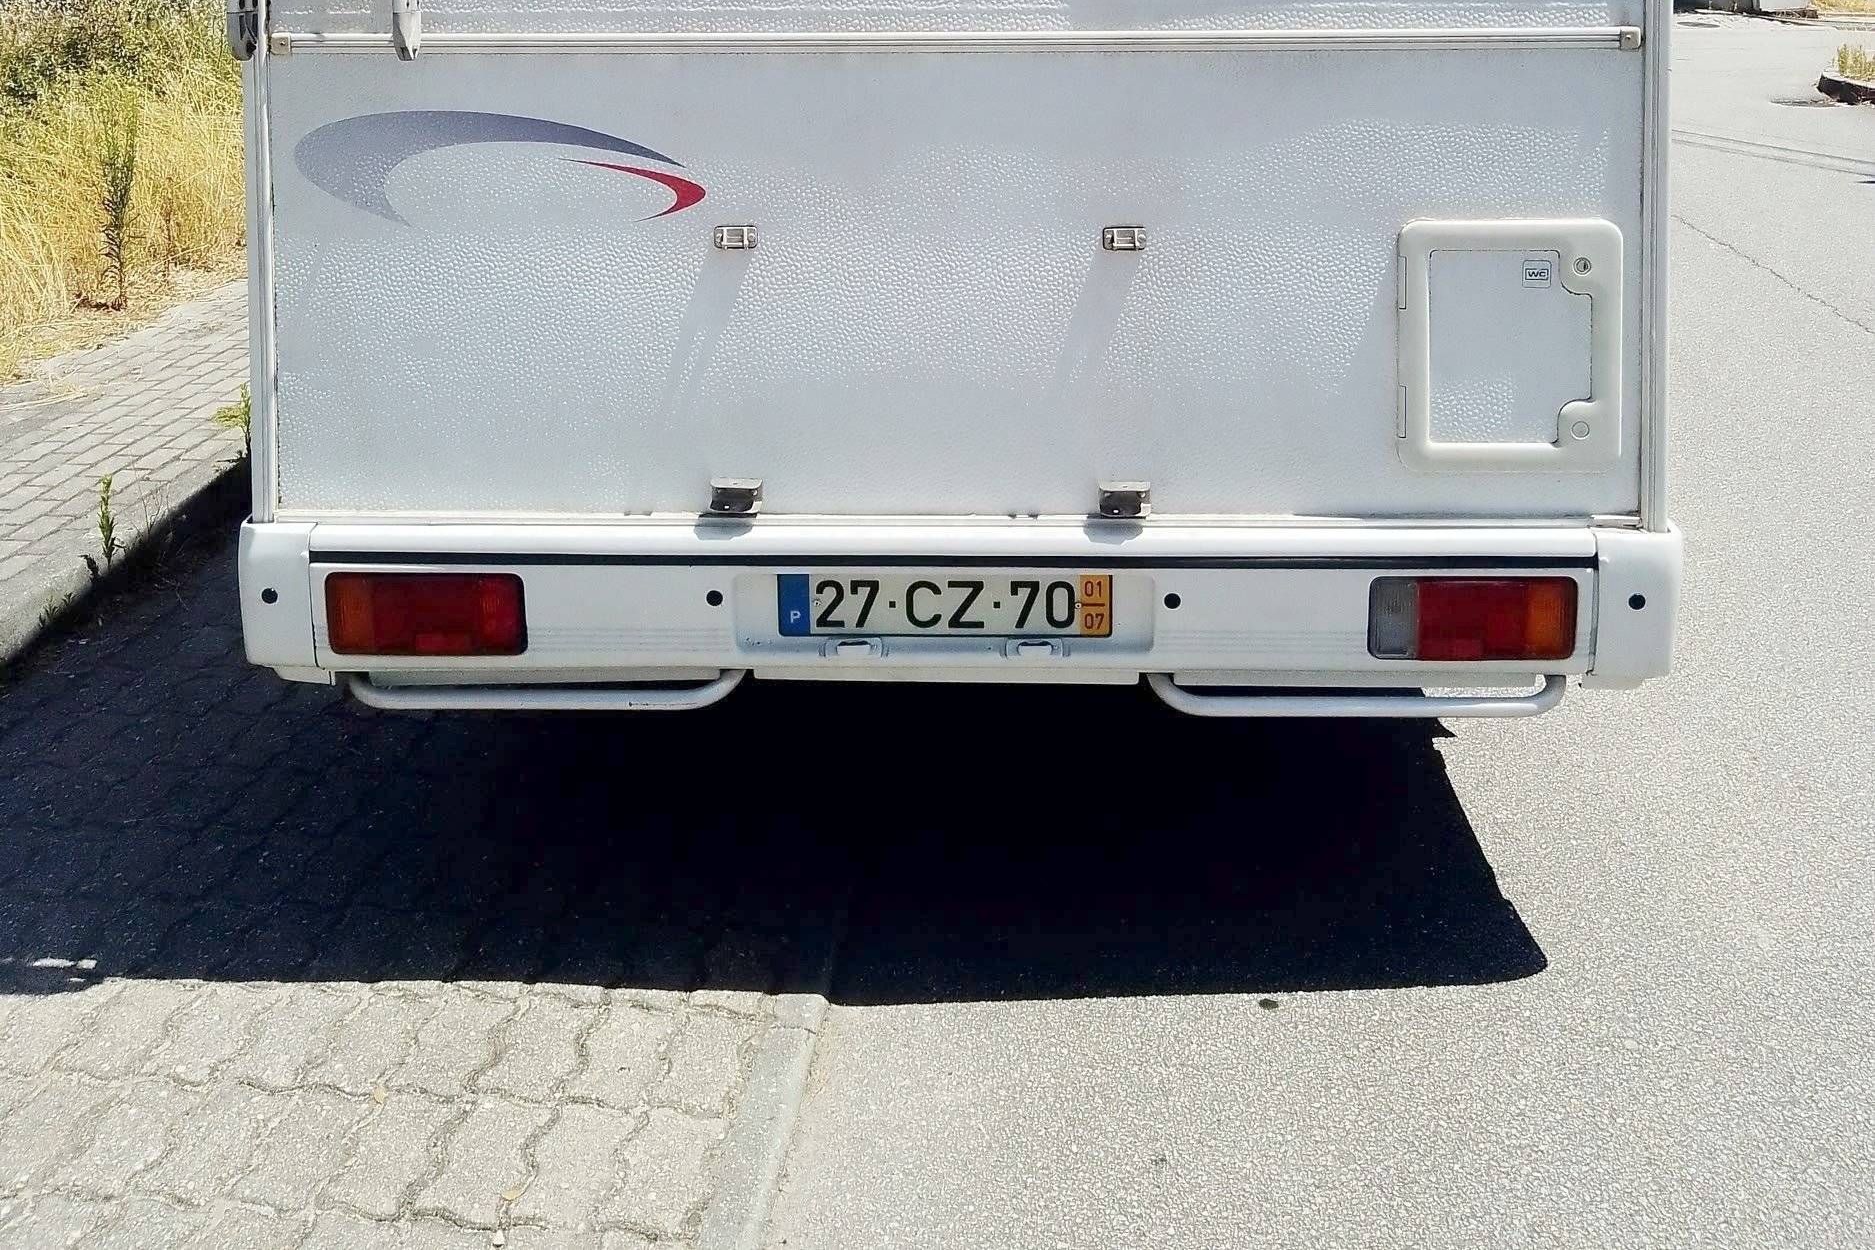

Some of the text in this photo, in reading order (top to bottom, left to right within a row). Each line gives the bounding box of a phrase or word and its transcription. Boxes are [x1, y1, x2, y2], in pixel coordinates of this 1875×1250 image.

[1527, 270, 1547, 278] WC
[1084, 580, 1103, 598] 01
[790, 611, 801, 624] P
[1084, 612, 1105, 630] 07
